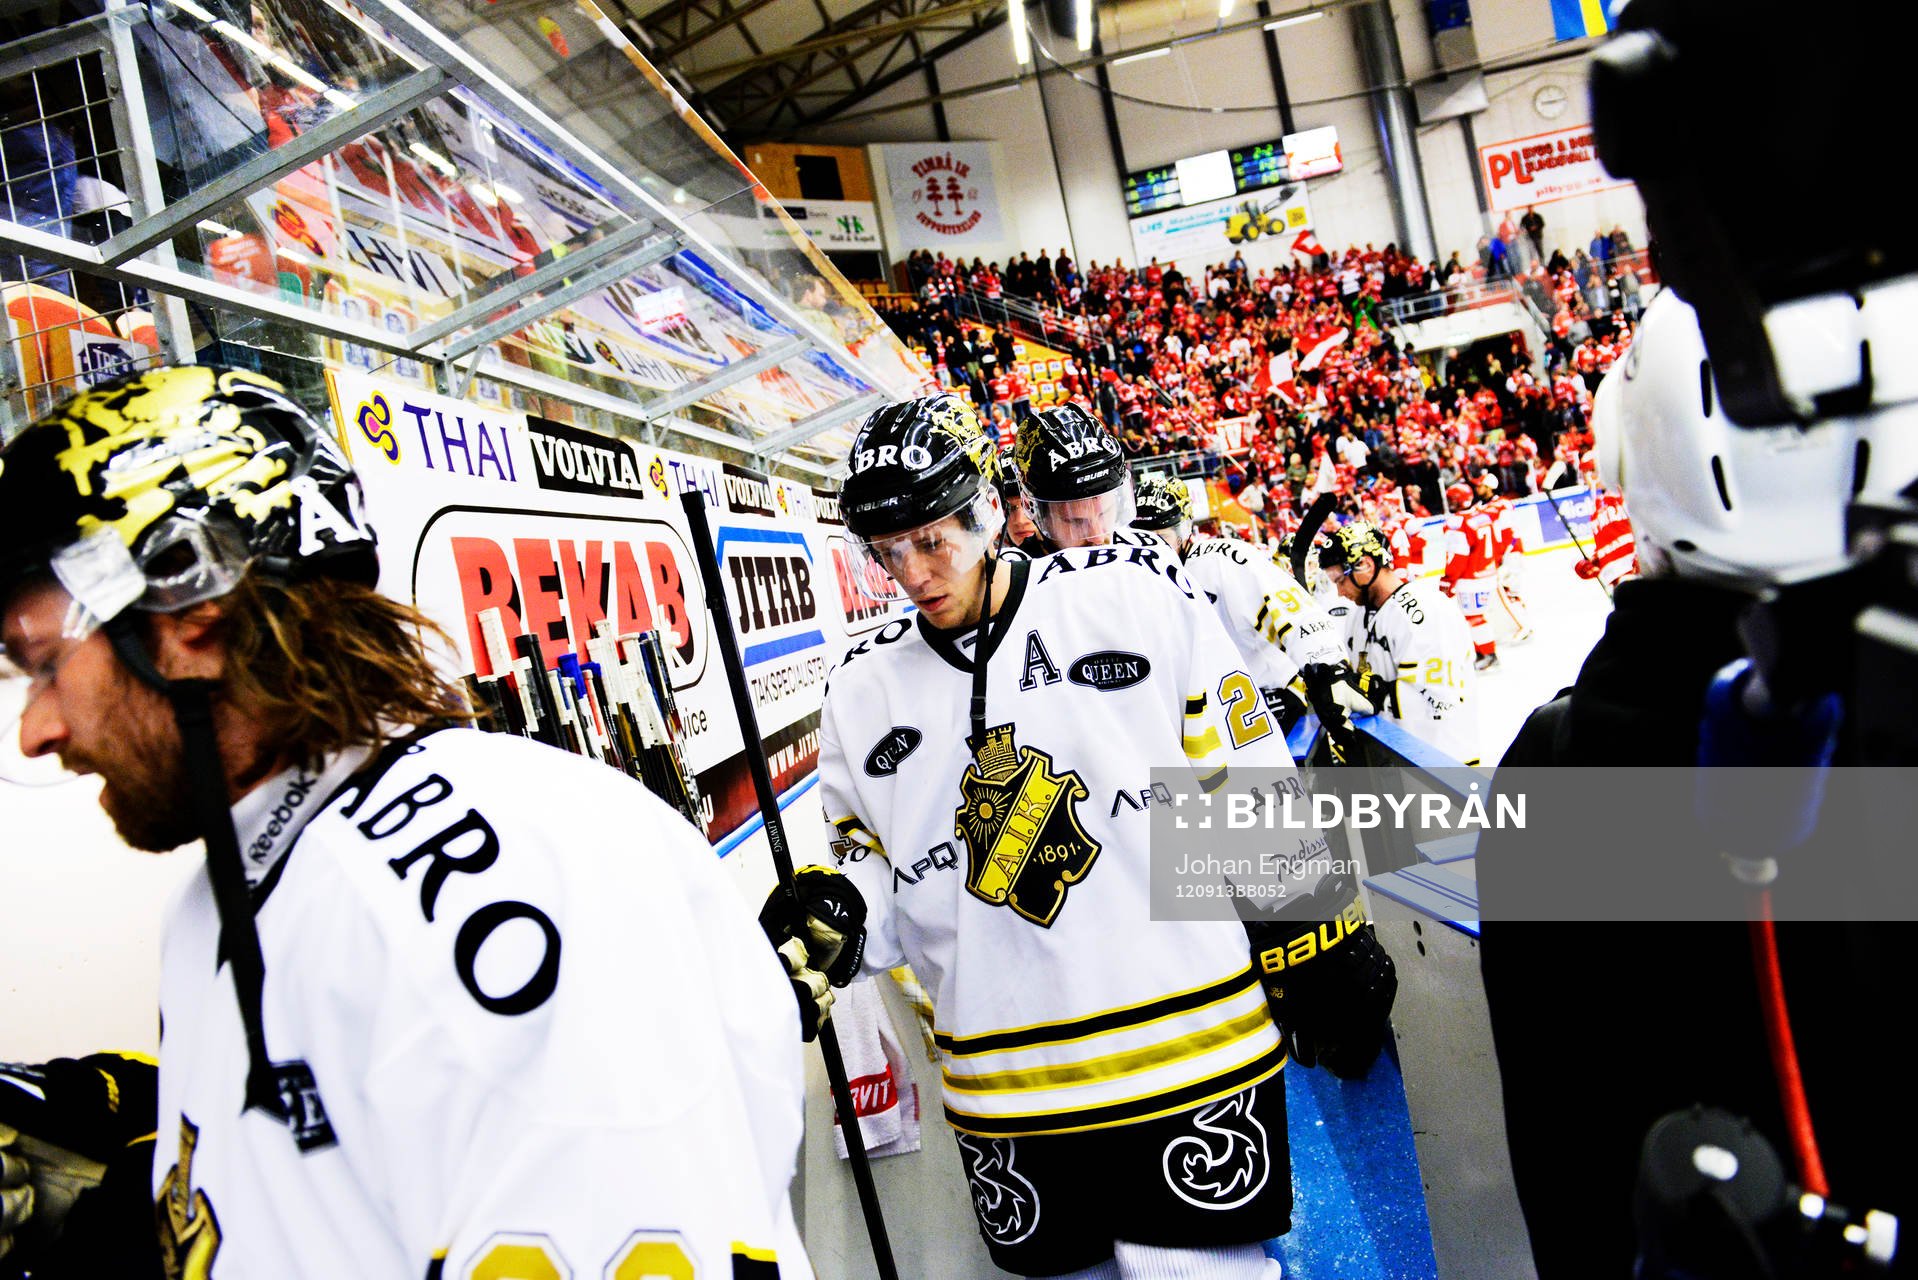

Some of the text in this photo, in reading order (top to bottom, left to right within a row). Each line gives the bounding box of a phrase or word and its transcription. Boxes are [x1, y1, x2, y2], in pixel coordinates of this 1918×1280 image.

[403, 401, 643, 490] THAI VOLVIA
[669, 460, 774, 511] THAI VOLVIA
[451, 537, 695, 680] REKAB
[728, 557, 816, 634] JITAB
[1019, 629, 1062, 692] A
[1082, 662, 1139, 683] QUEEN
[248, 771, 318, 865] Reebok
